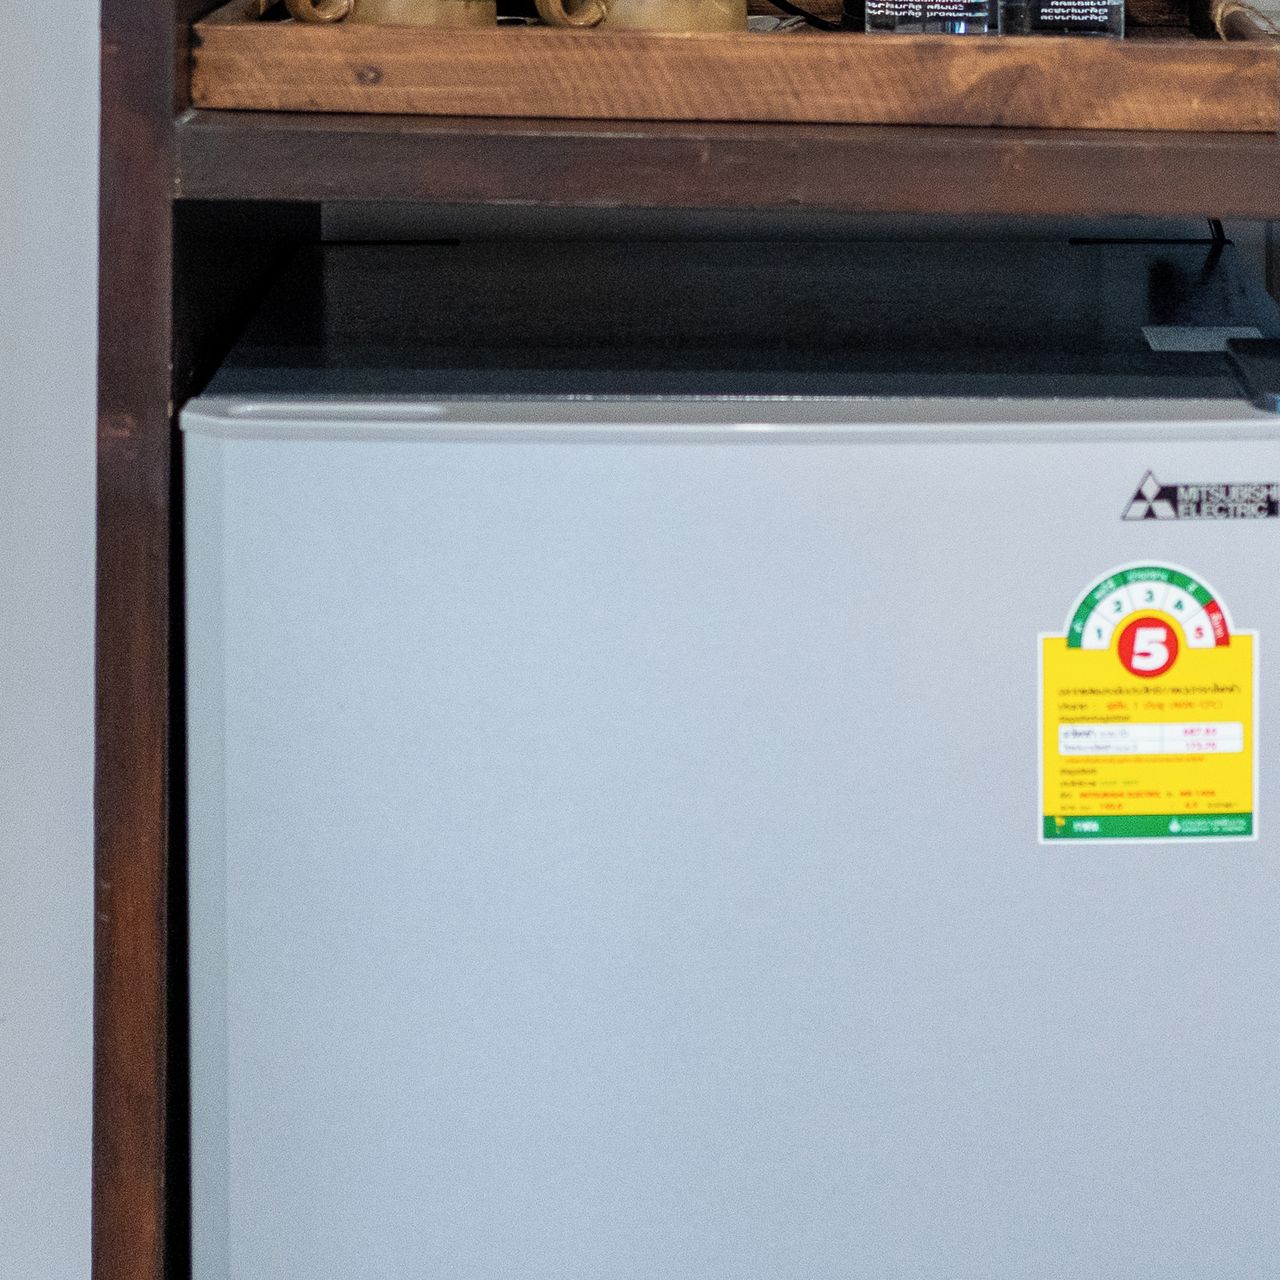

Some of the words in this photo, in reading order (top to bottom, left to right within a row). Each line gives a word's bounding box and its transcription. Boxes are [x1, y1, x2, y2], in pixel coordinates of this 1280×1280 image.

[1144, 589, 1155, 603] 3
[1112, 600, 1122, 613] 2
[1173, 600, 1185, 612] 4
[1096, 627, 1103, 640] 1
[1194, 627, 1205, 640] 5
[1131, 626, 1169, 671] 5
